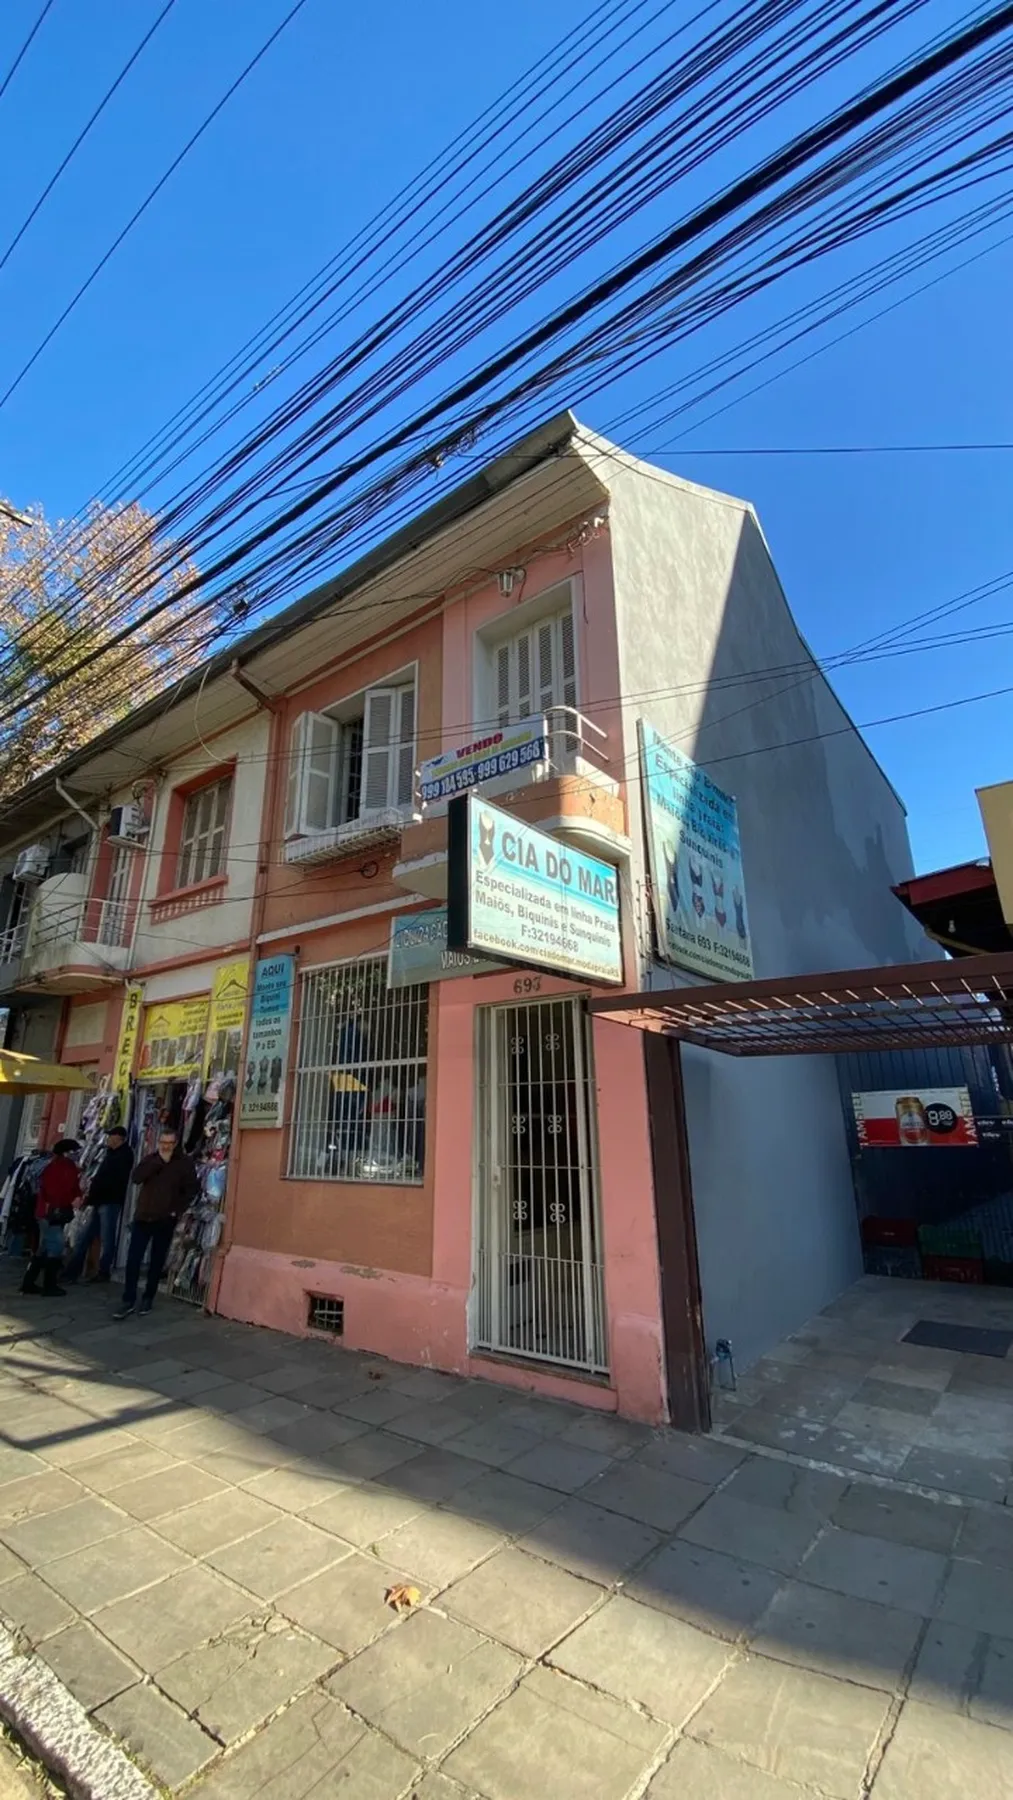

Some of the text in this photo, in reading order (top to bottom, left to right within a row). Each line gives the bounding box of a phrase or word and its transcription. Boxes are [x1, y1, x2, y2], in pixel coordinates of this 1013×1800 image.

[456, 732, 503, 759] VENDO
[422, 783, 440, 800] 999
[499, 750, 518, 771] 629
[520, 740, 540, 763] 568
[501, 831, 615, 905] CIA DO MAR
[475, 870, 616, 933] Especializada em linha Praia
[517, 903, 559, 928] Biquinis
[561, 921, 568, 932] e
[569, 922, 611, 948] Sunquinis
[521, 924, 579, 952] F:32194668
[261, 963, 285, 977] AQUI
